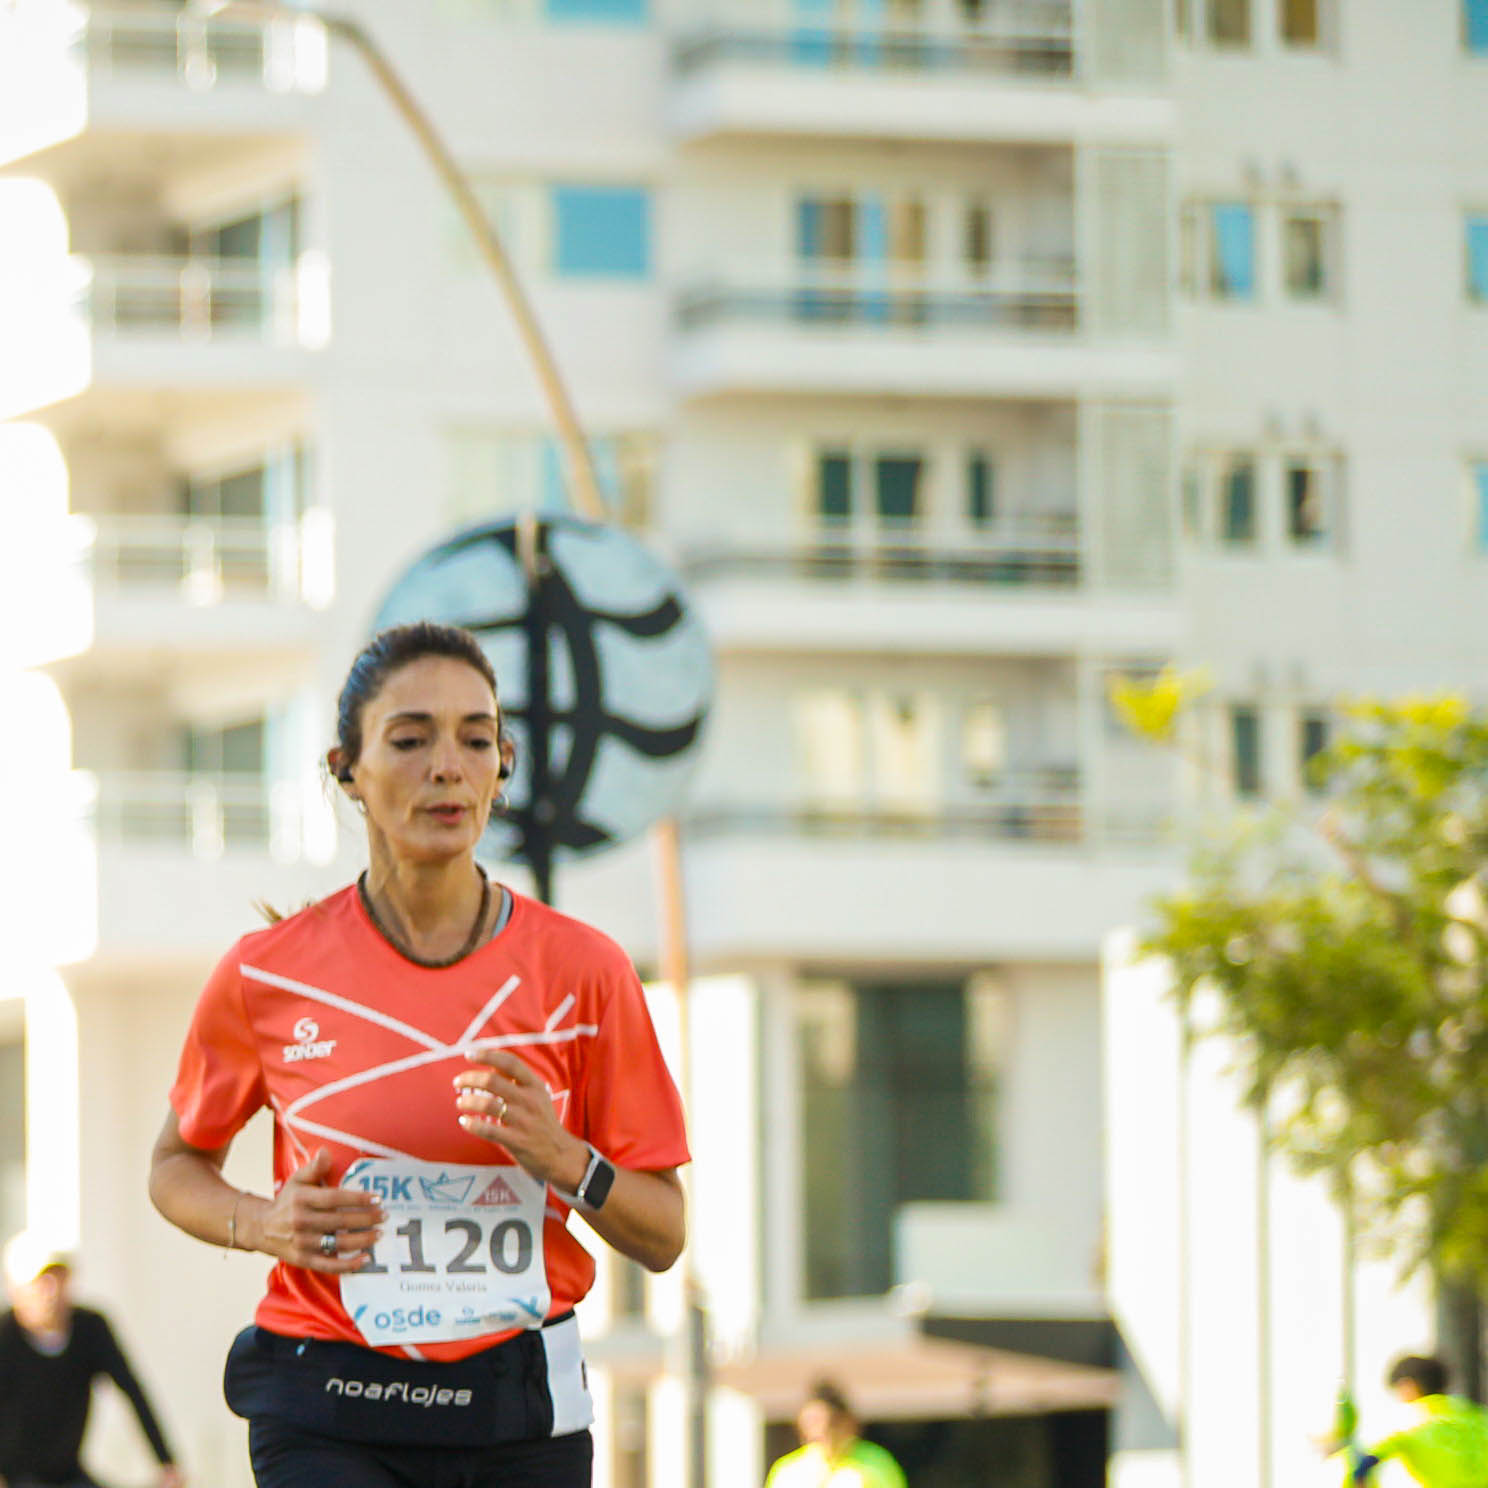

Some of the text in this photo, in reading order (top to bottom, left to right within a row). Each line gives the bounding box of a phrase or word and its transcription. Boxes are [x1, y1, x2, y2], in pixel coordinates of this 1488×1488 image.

[358, 1175, 413, 1201] 15K
[374, 1305, 442, 1330] osde
[326, 1377, 473, 1408] noaflojes
